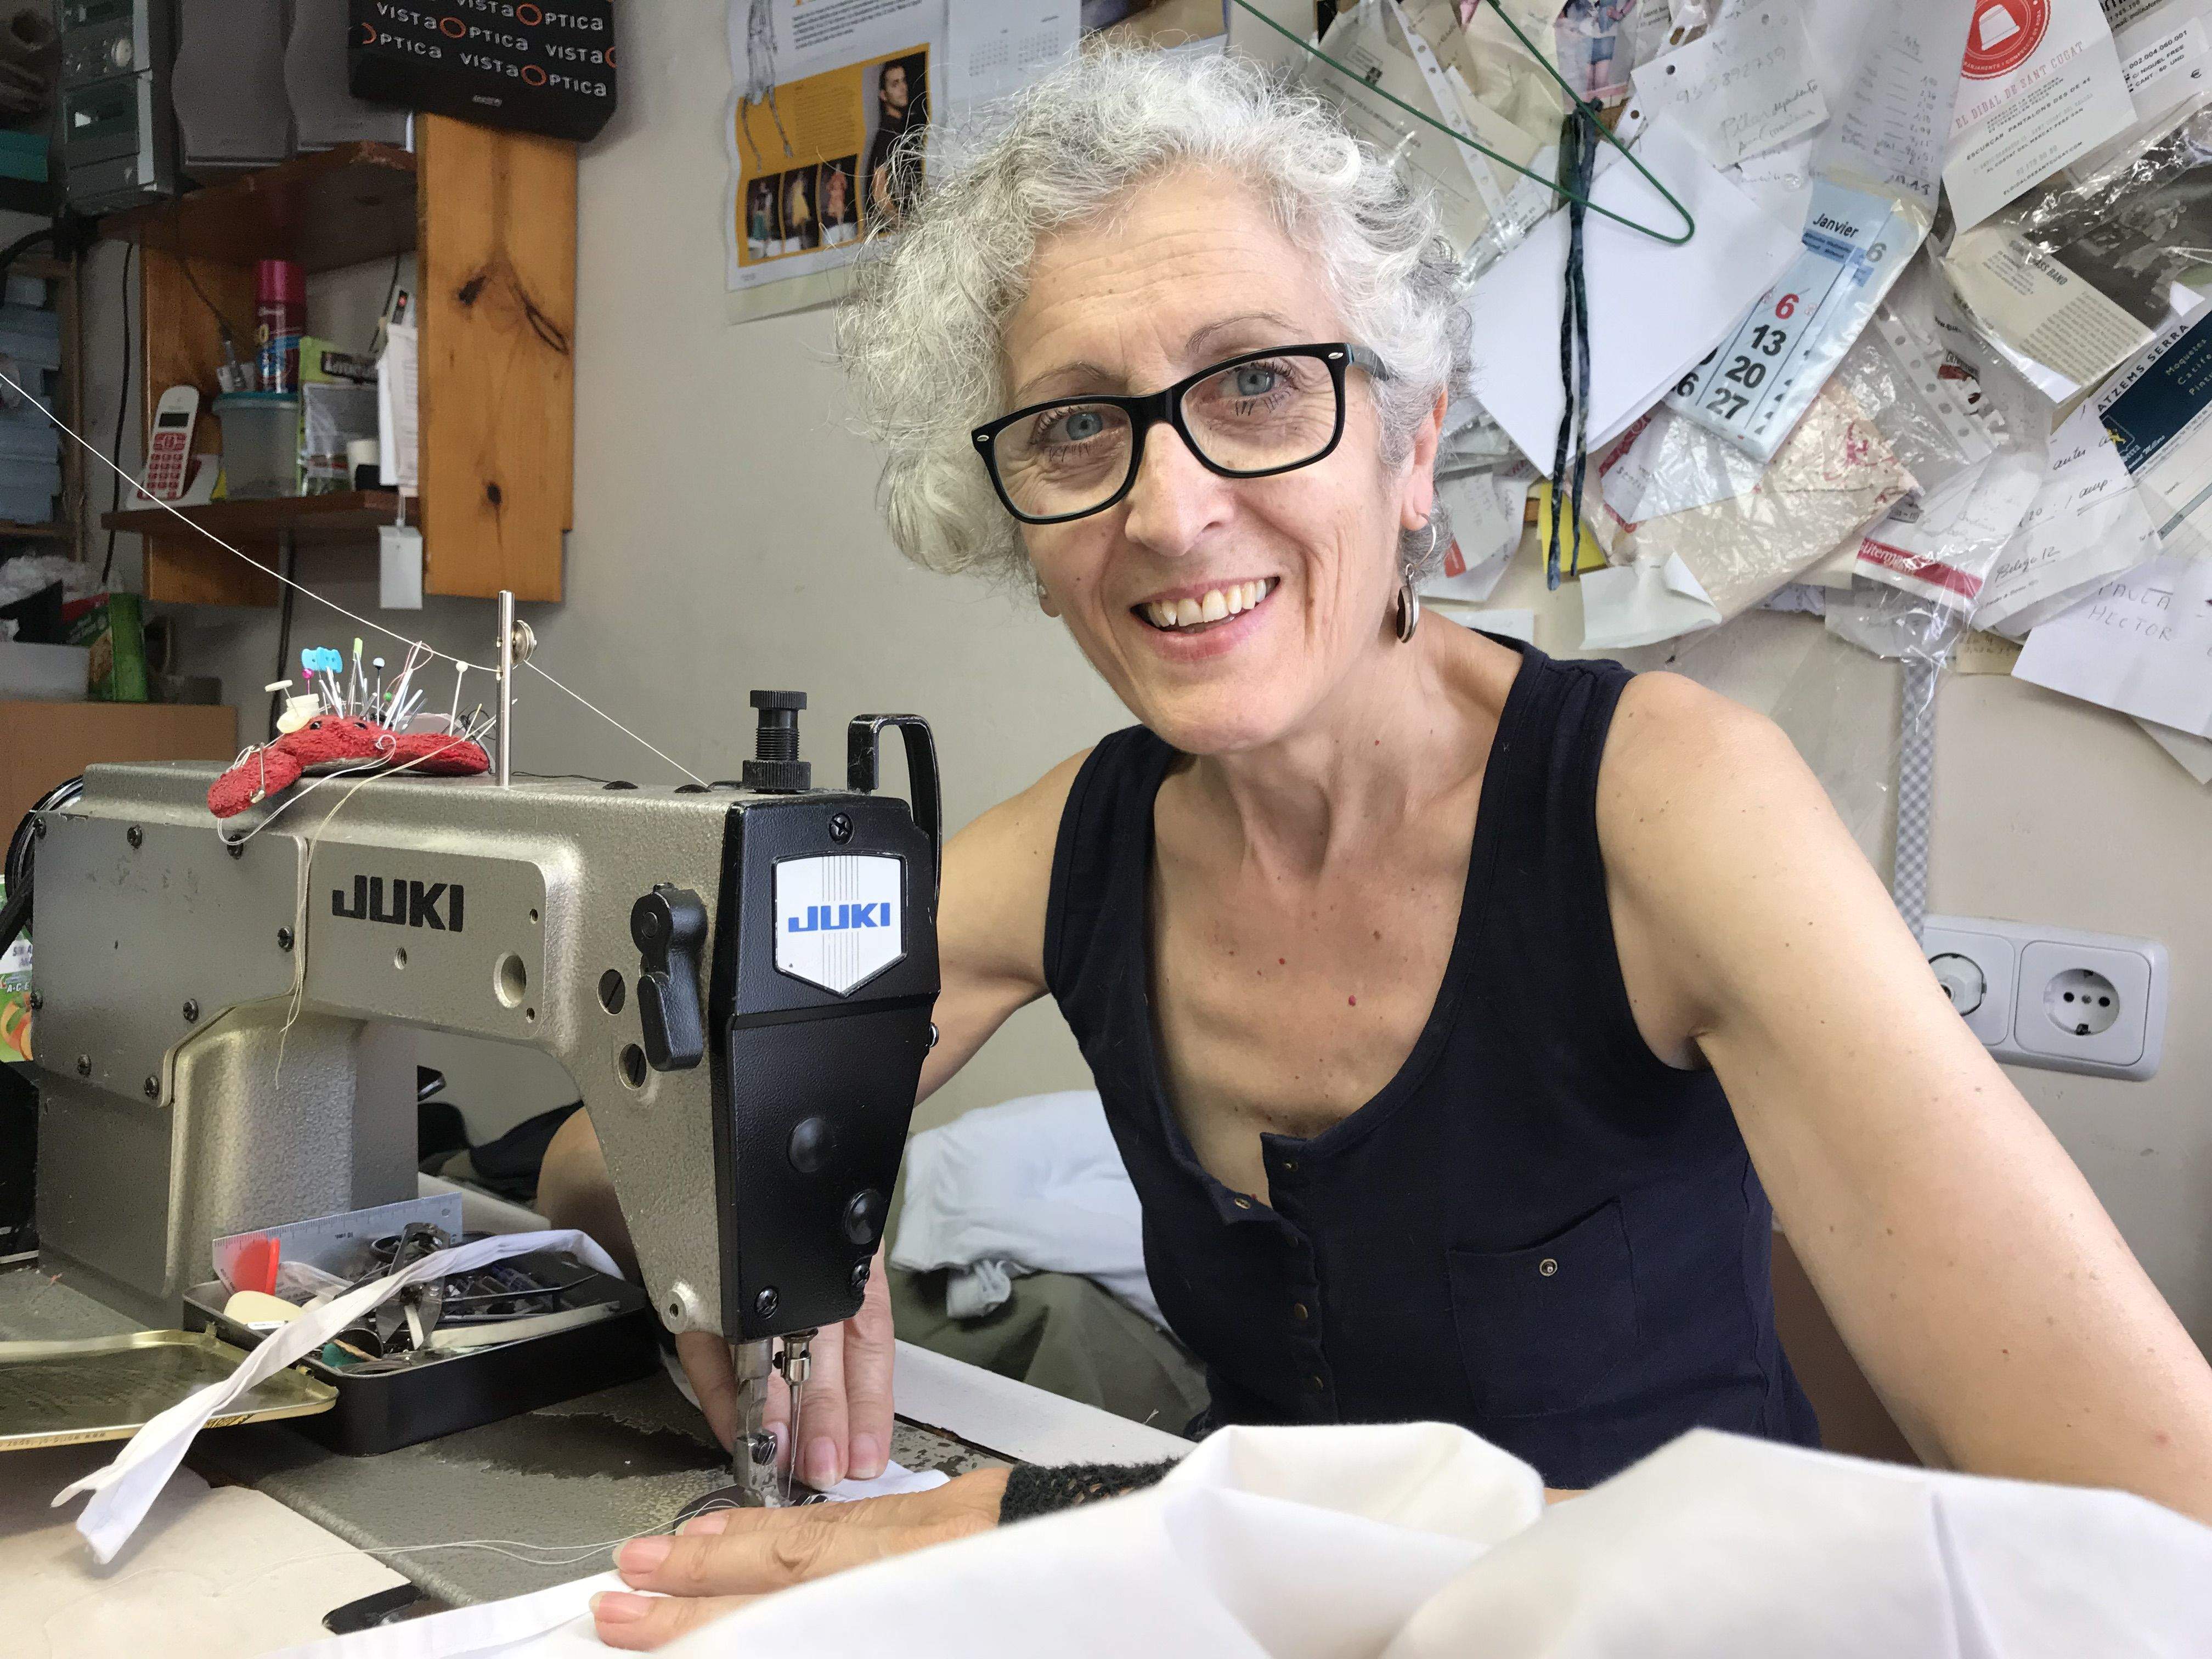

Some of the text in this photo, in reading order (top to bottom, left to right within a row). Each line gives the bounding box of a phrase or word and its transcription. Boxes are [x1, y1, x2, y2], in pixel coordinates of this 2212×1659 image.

[2140, 57, 2165, 75] NIQUEL
[2166, 44, 2185, 58] FREE
[1955, 115, 1969, 129] EL
[1971, 94, 2002, 120] DIDAL
[2004, 84, 2018, 99] DE
[2020, 65, 2047, 89] SANT
[2051, 40, 2084, 69] CUGAT
[1812, 213, 1860, 238] Janvier
[1775, 292, 1800, 320] 6
[1751, 324, 1787, 357] 13
[2147, 324, 2190, 362] SERRA
[1670, 371, 1700, 397] 6
[1724, 355, 1767, 389] 20
[1705, 387, 1750, 420] 27
[332, 875, 464, 932] JUKI
[788, 902, 890, 933] JUKI
